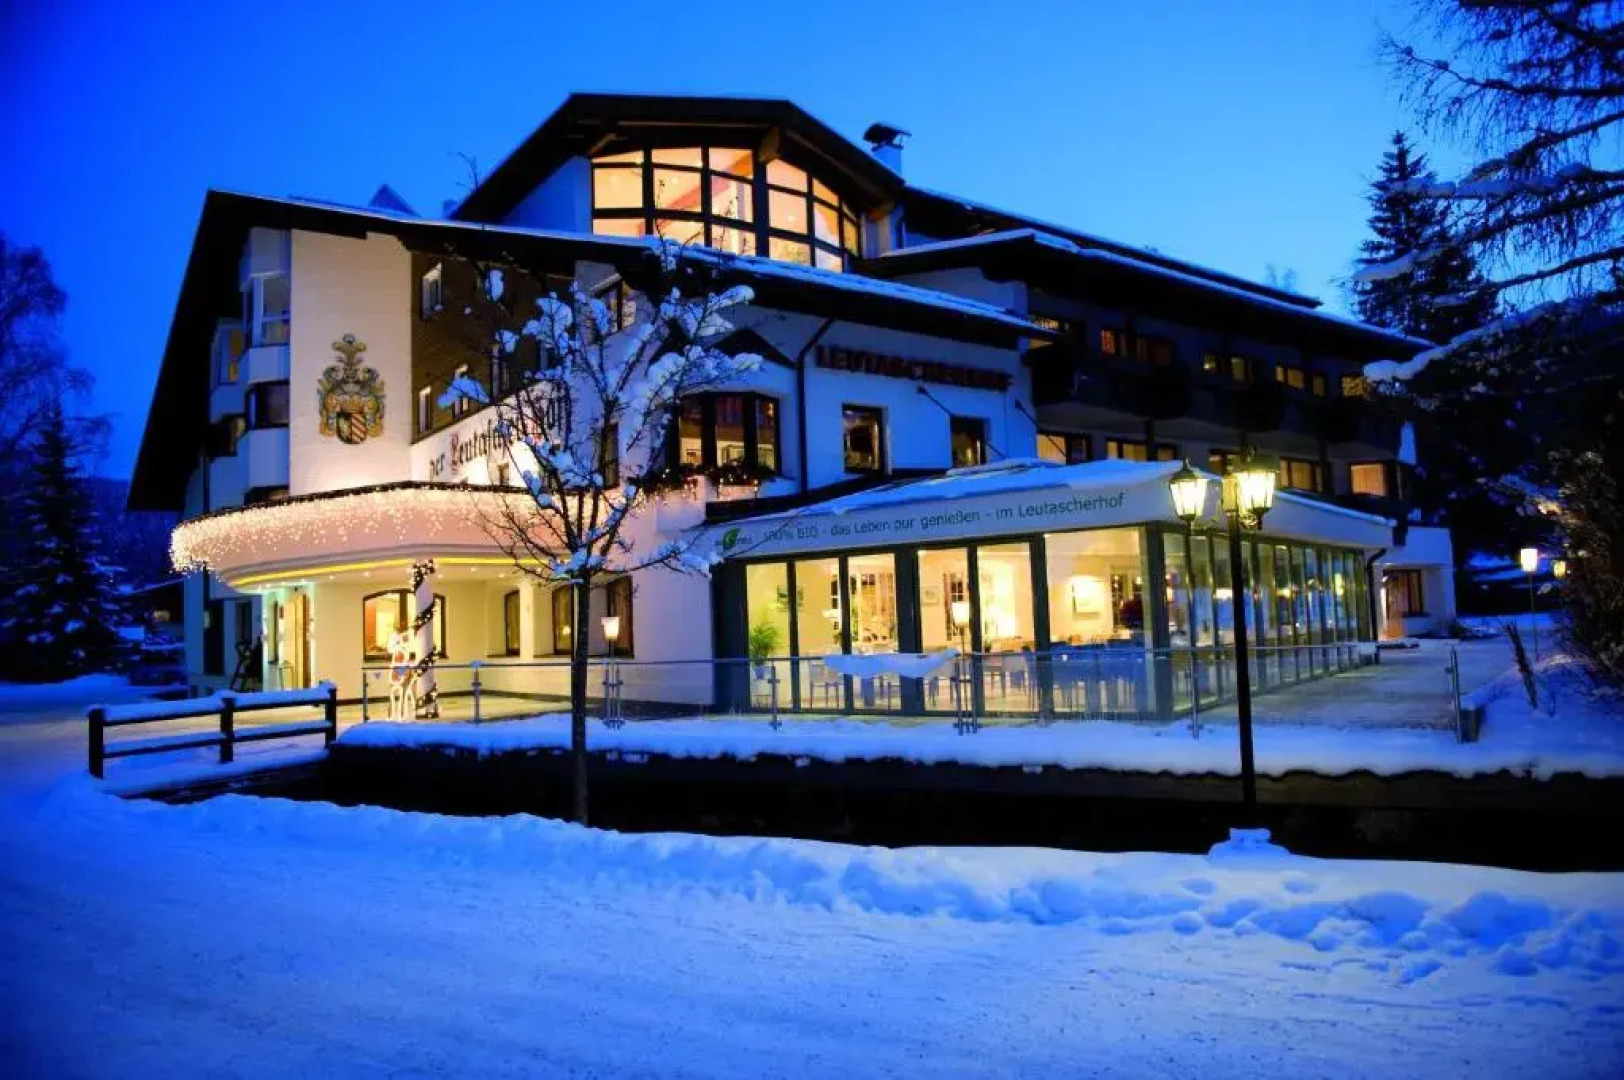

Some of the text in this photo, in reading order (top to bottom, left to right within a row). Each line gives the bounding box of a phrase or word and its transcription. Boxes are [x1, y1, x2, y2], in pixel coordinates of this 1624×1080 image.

[797, 526, 818, 539] BIO
[831, 524, 851, 536] das
[854, 518, 891, 535] Leben
[894, 518, 915, 532] pur
[920, 509, 980, 530] genießen
[1018, 491, 1125, 518] Leutascherhof
